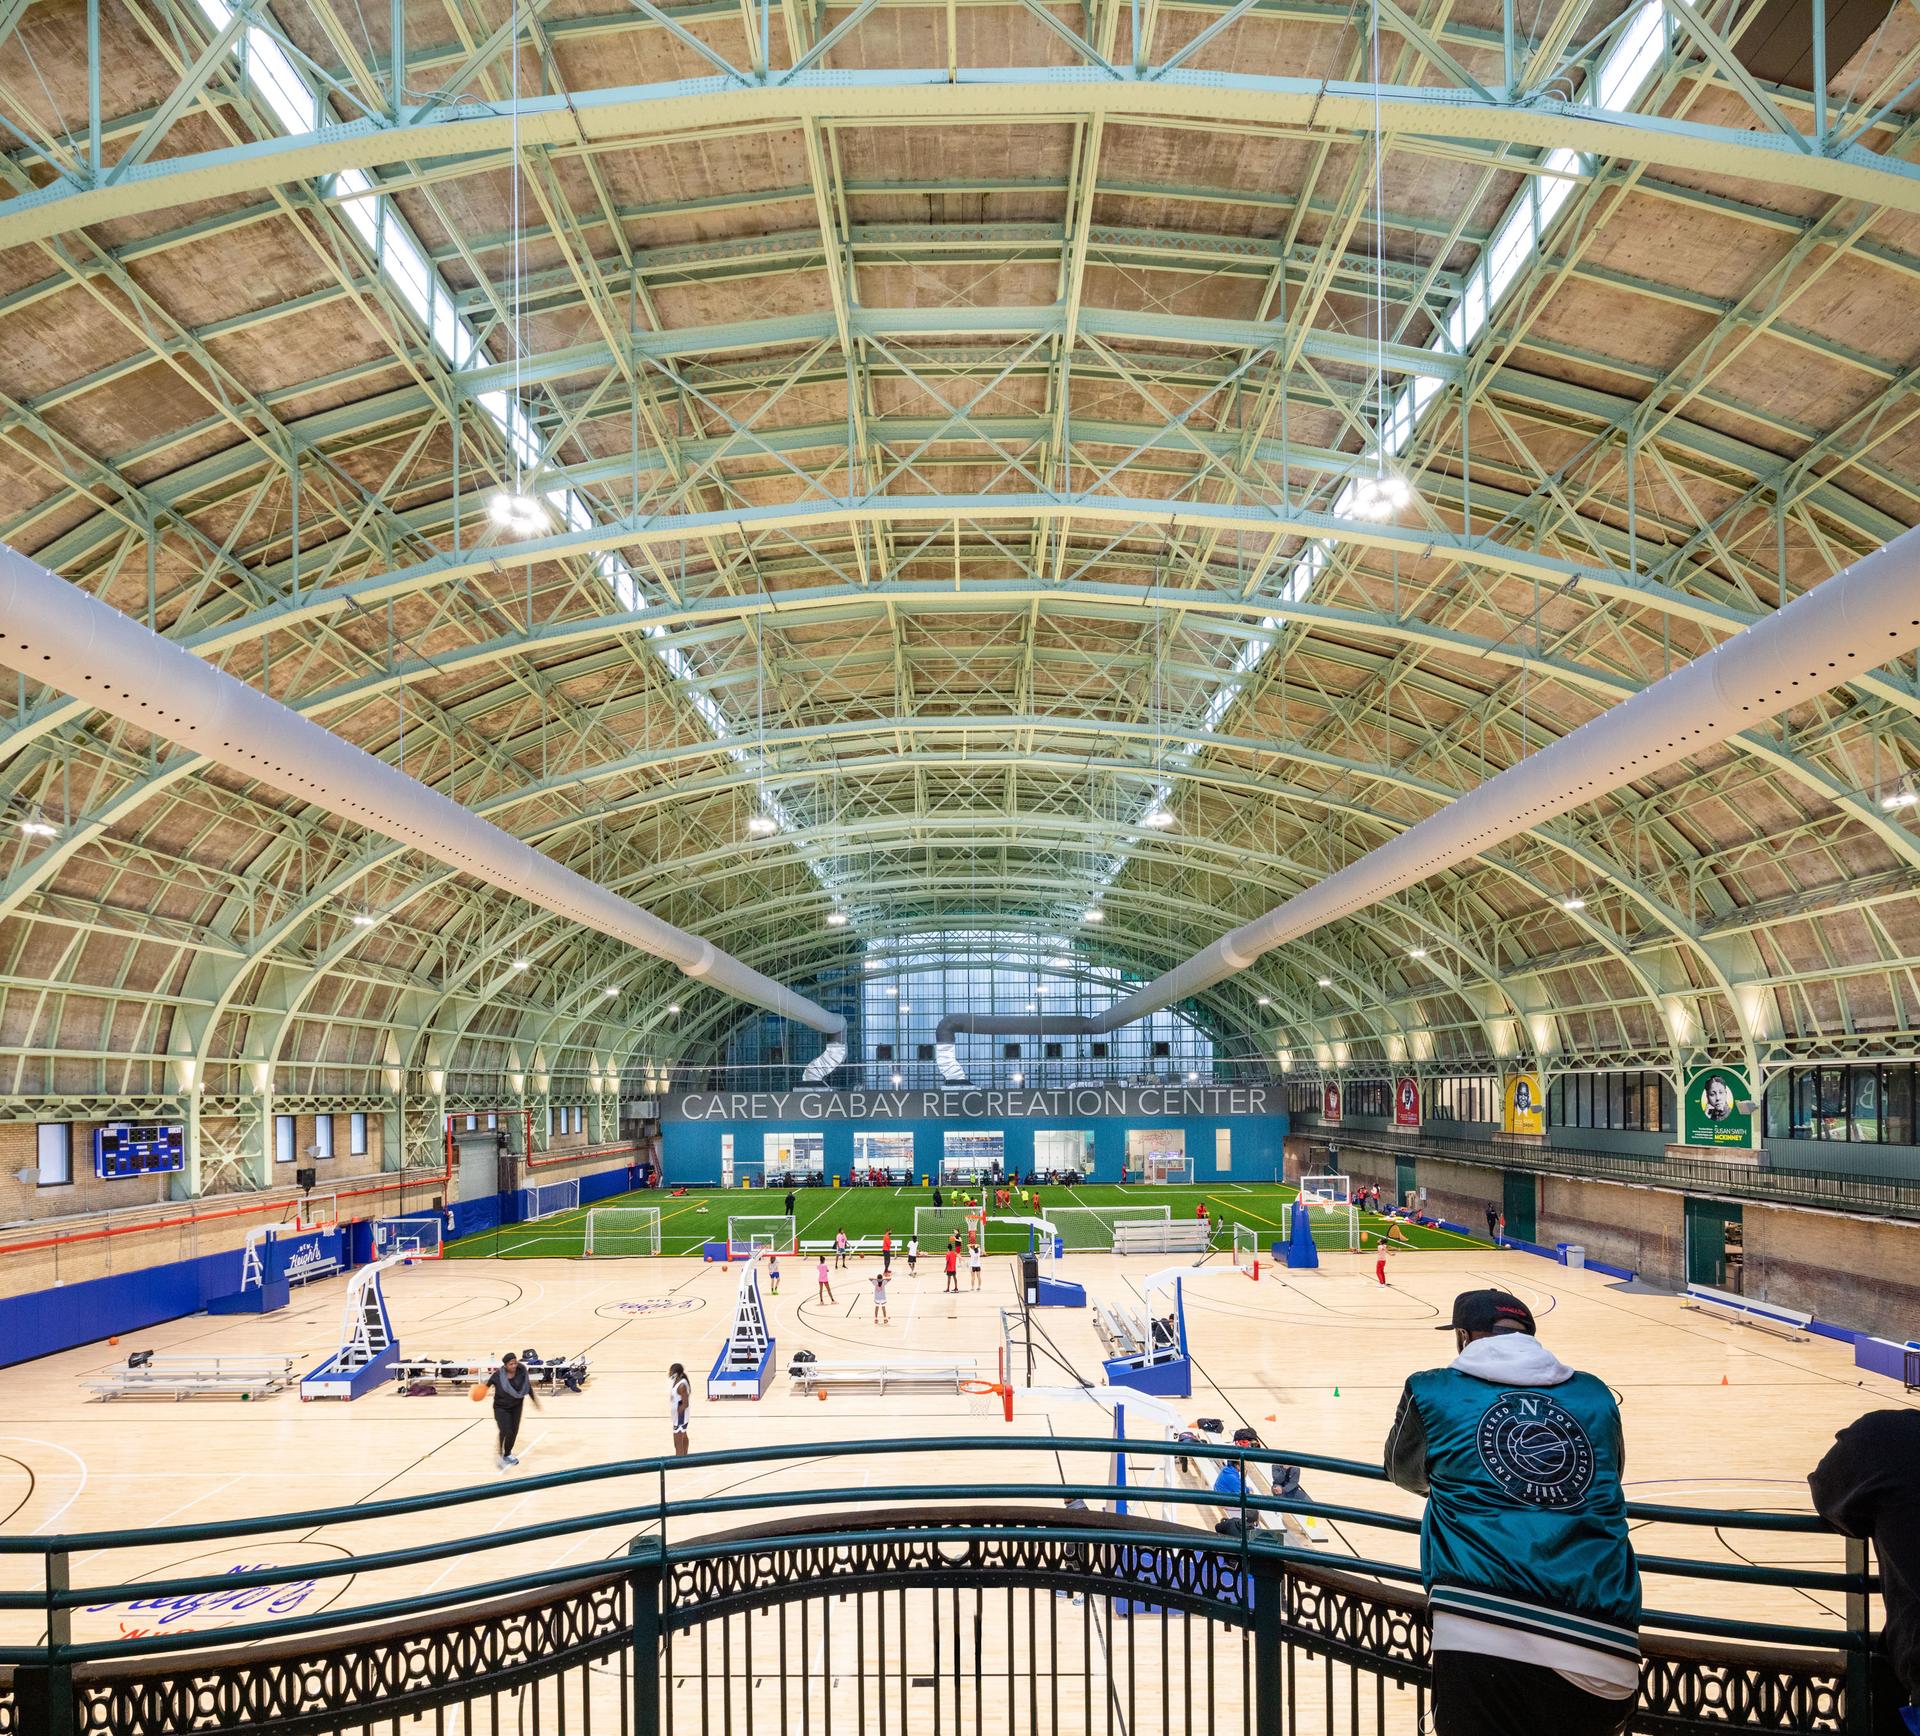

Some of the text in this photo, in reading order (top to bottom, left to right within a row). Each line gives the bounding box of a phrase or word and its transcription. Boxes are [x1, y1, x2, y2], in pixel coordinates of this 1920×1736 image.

[681, 1088, 1267, 1120] CAREY GABAY RECREATION CENTER
[1519, 1398, 1541, 1417] N
[1484, 1406, 1588, 1487] ENGINEERED FOR VICTORY
[1526, 1483, 1565, 1498] SINCE
